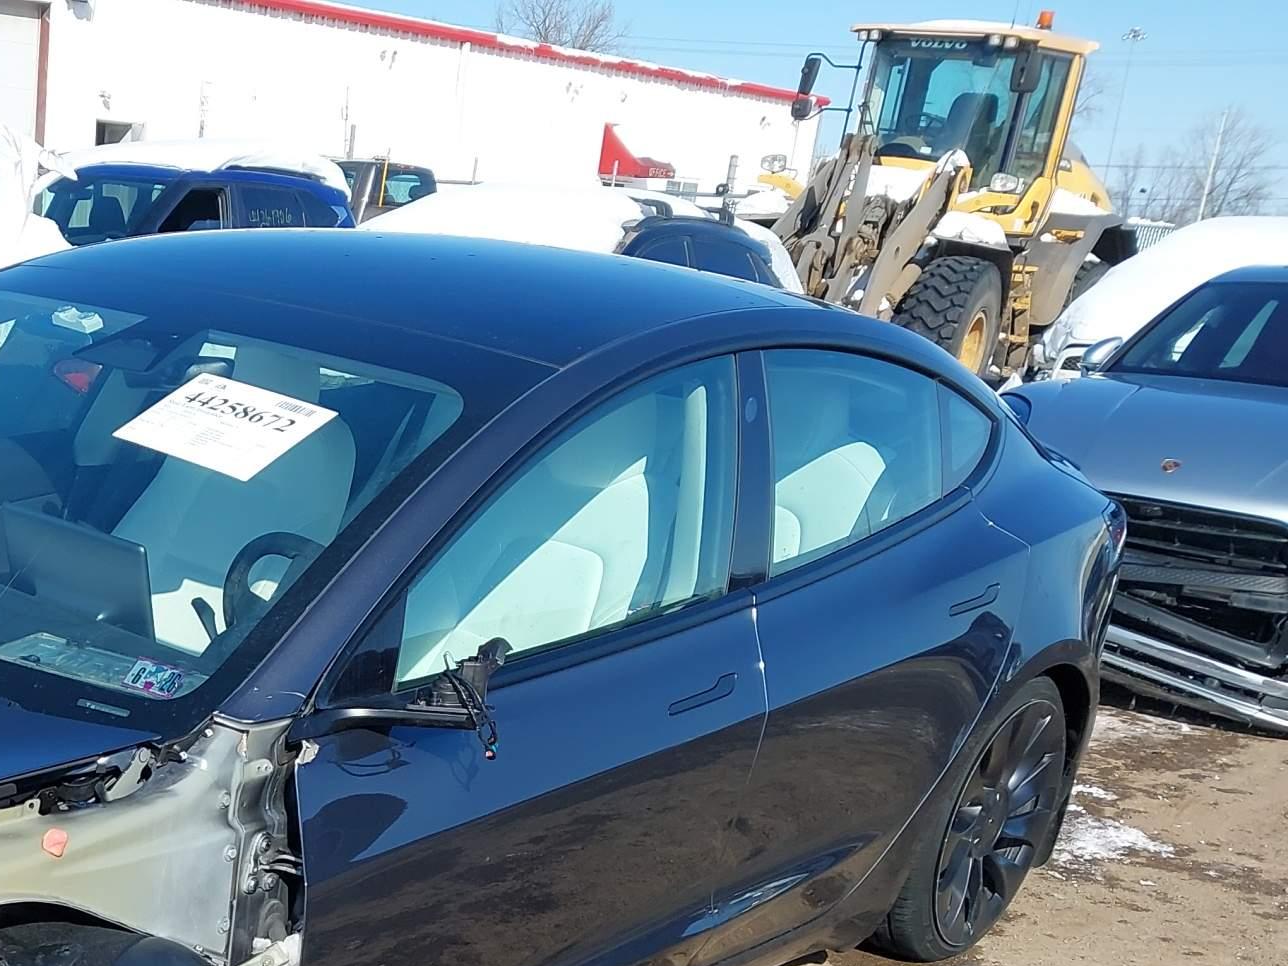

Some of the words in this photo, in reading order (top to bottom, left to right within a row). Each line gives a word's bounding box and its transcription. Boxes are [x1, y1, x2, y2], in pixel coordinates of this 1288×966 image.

[911, 38, 968, 49] VOLVO
[185, 391, 297, 433] 44258672
[131, 666, 147, 685] 6
